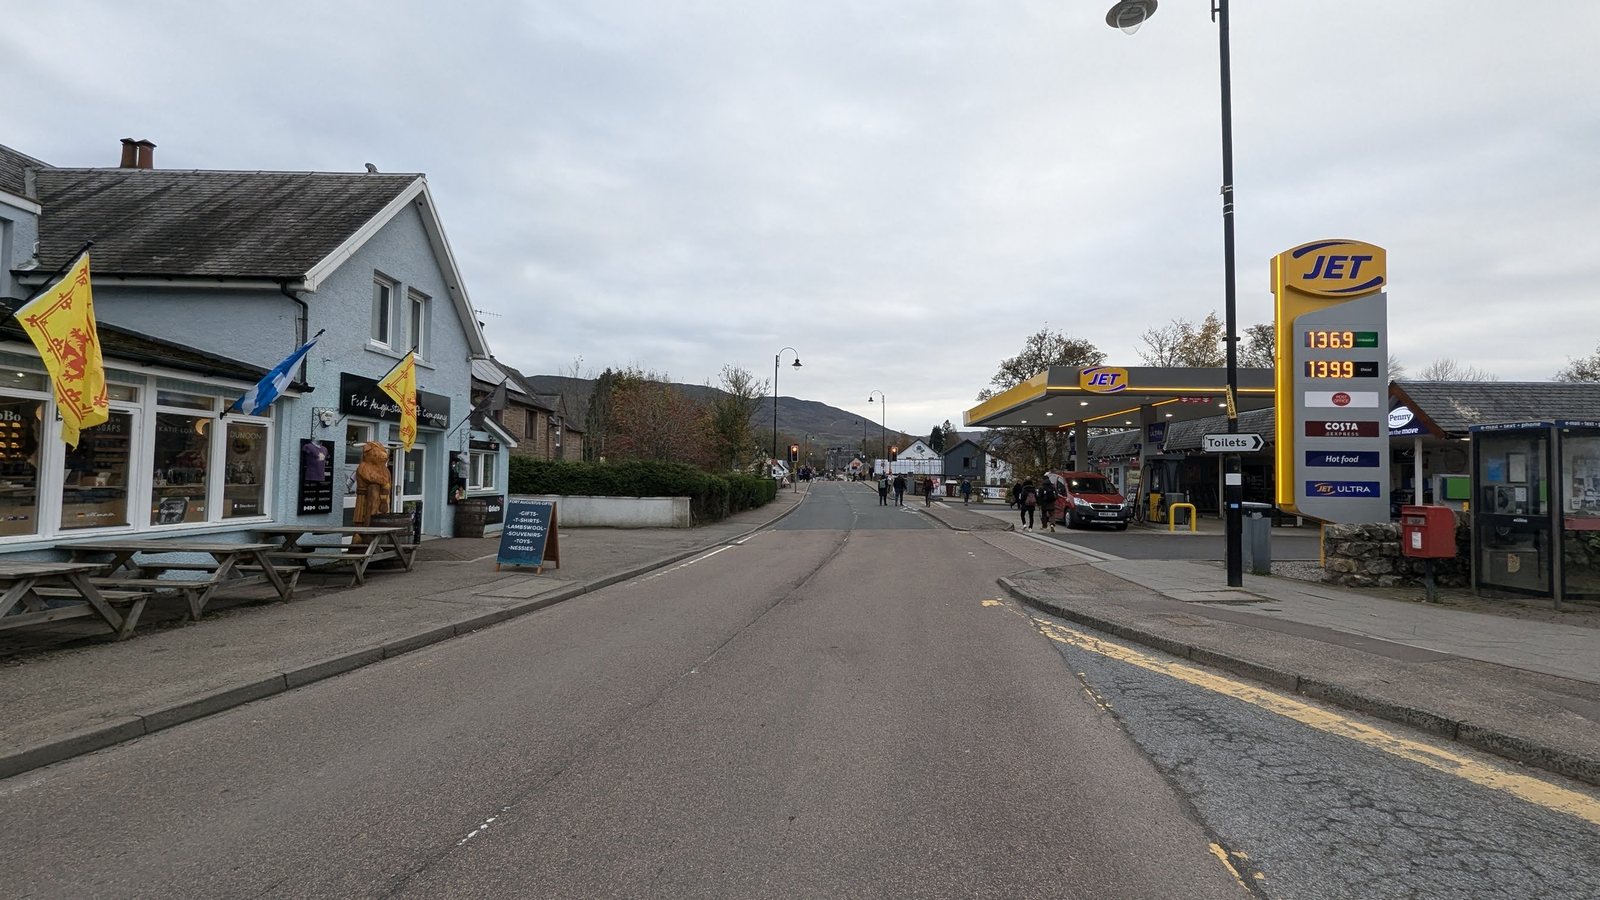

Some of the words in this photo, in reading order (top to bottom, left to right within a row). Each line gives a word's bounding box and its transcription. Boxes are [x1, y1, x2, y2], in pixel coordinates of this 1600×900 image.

[1302, 255, 1373, 279] JET
[1309, 331, 1353, 349] 136.9
[1309, 361, 1353, 378] 139.9
[1087, 373, 1121, 386] JET
[370, 400, 402, 417] Augustu
[422, 409, 447, 426] Company
[1325, 423, 1358, 431] COSTA
[1208, 438, 1247, 447] Toilets
[1341, 455, 1359, 464] food
